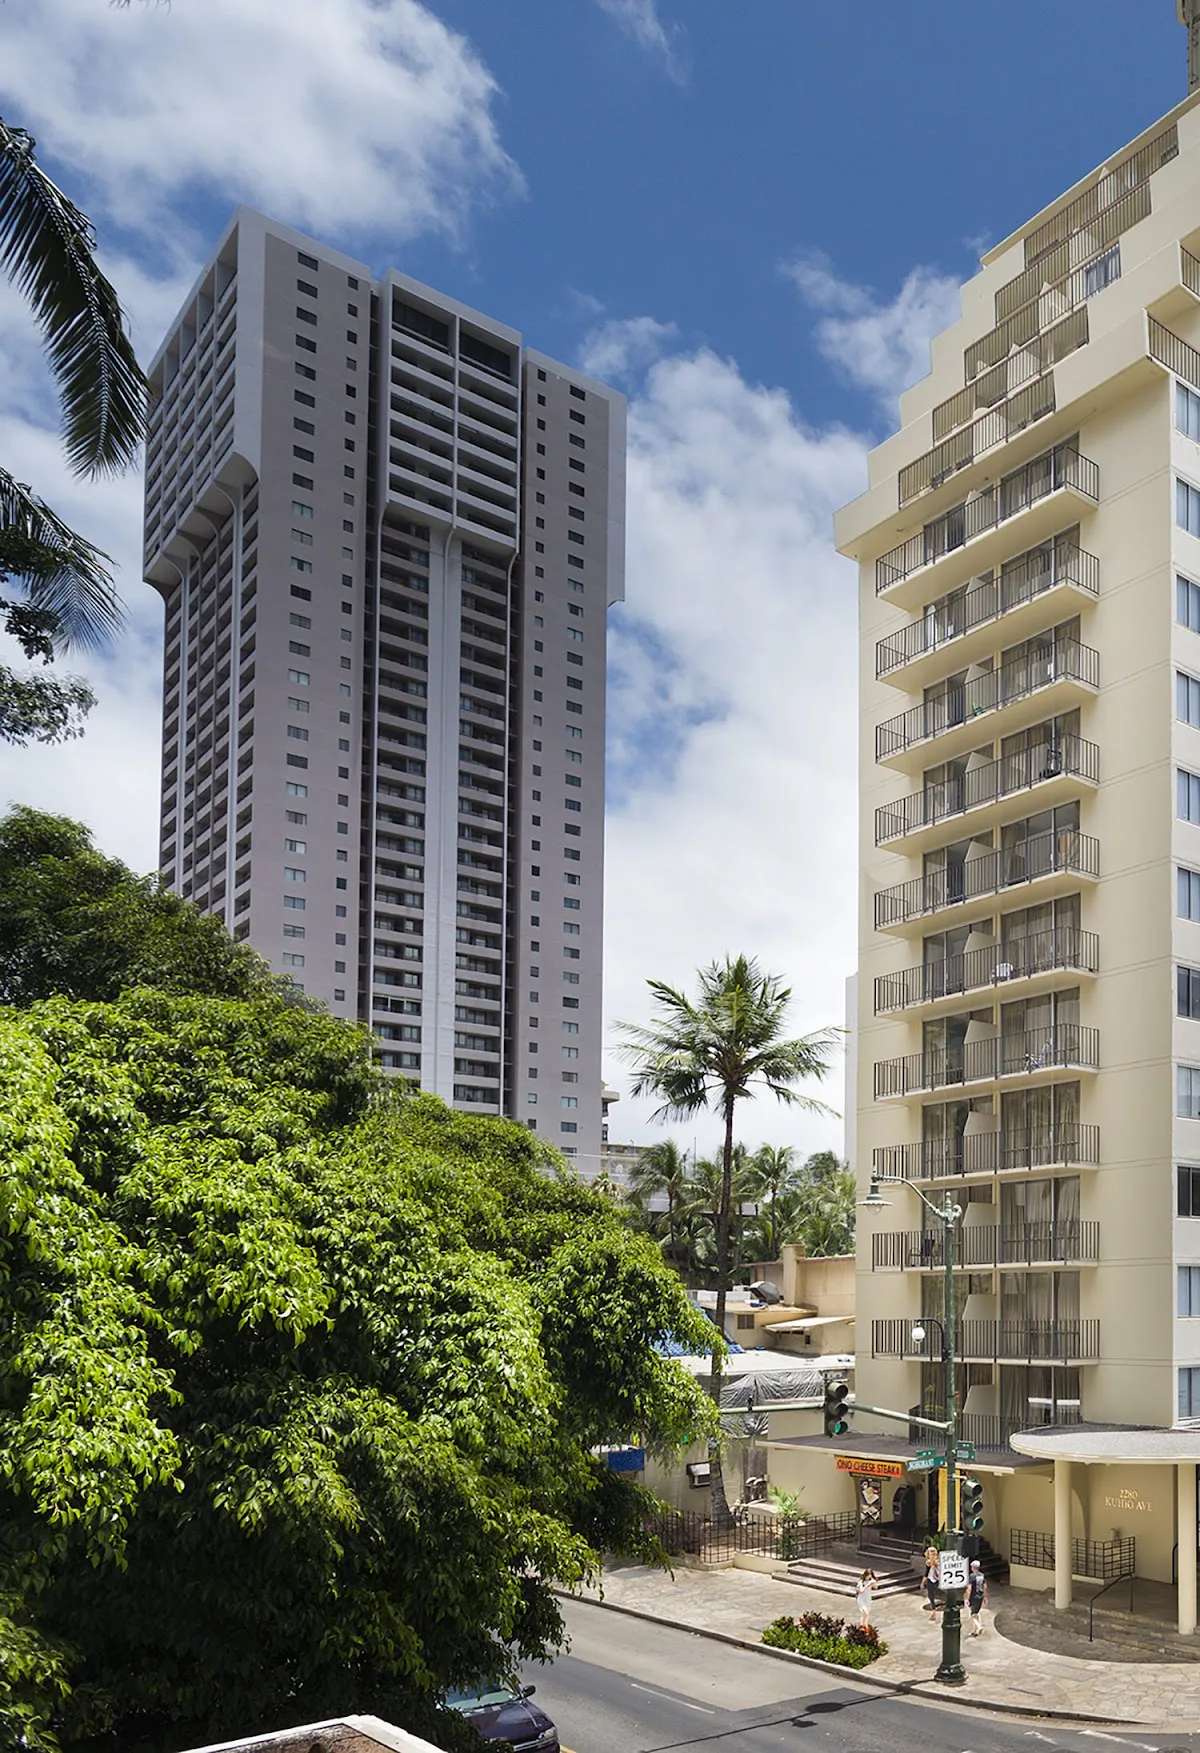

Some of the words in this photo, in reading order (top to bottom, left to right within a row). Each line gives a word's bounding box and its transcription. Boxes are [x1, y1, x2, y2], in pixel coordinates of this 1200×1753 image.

[837, 1459, 852, 1470] ONO
[854, 1462, 875, 1473] CHEESE
[1120, 1489, 1138, 1499] 2280
[1105, 1497, 1134, 1509] KUHIO
[1136, 1501, 1153, 1511] AVE
[943, 1570, 965, 1584] 25
